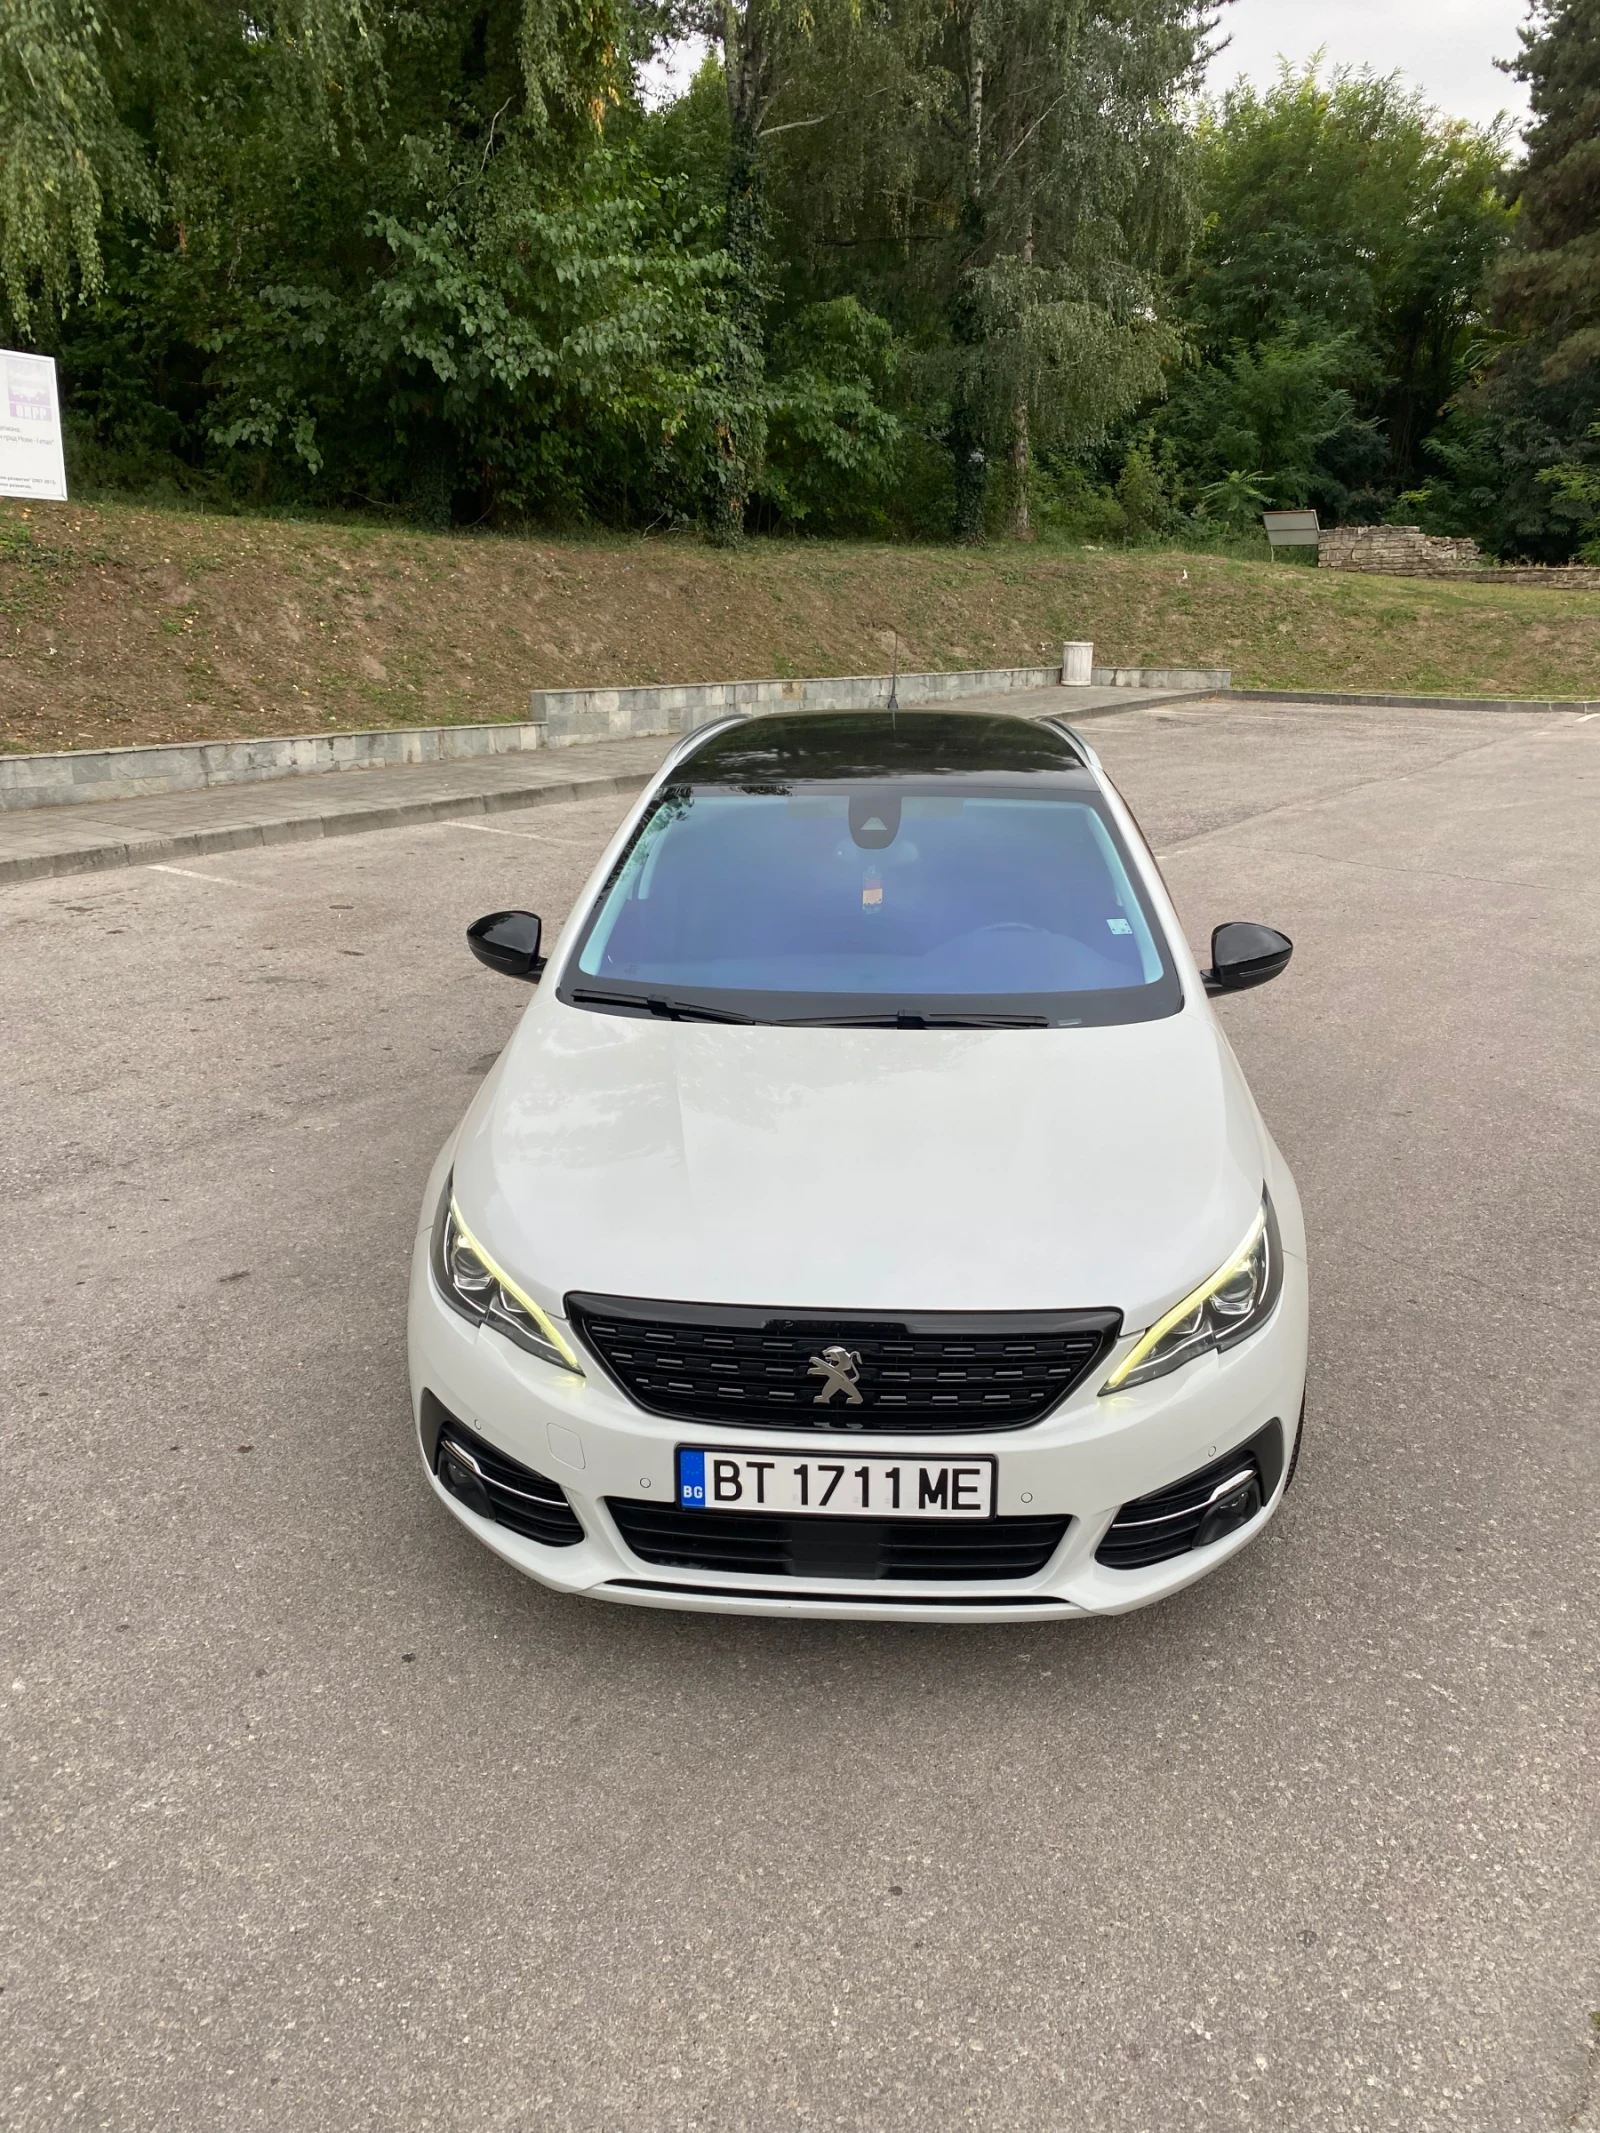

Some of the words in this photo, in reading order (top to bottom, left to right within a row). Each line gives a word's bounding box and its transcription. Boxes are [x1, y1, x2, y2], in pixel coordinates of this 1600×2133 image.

[683, 1486, 703, 1498] BG
[713, 1459, 775, 1503] BT
[793, 1464, 900, 1508] 1711
[919, 1467, 981, 1510] ME
